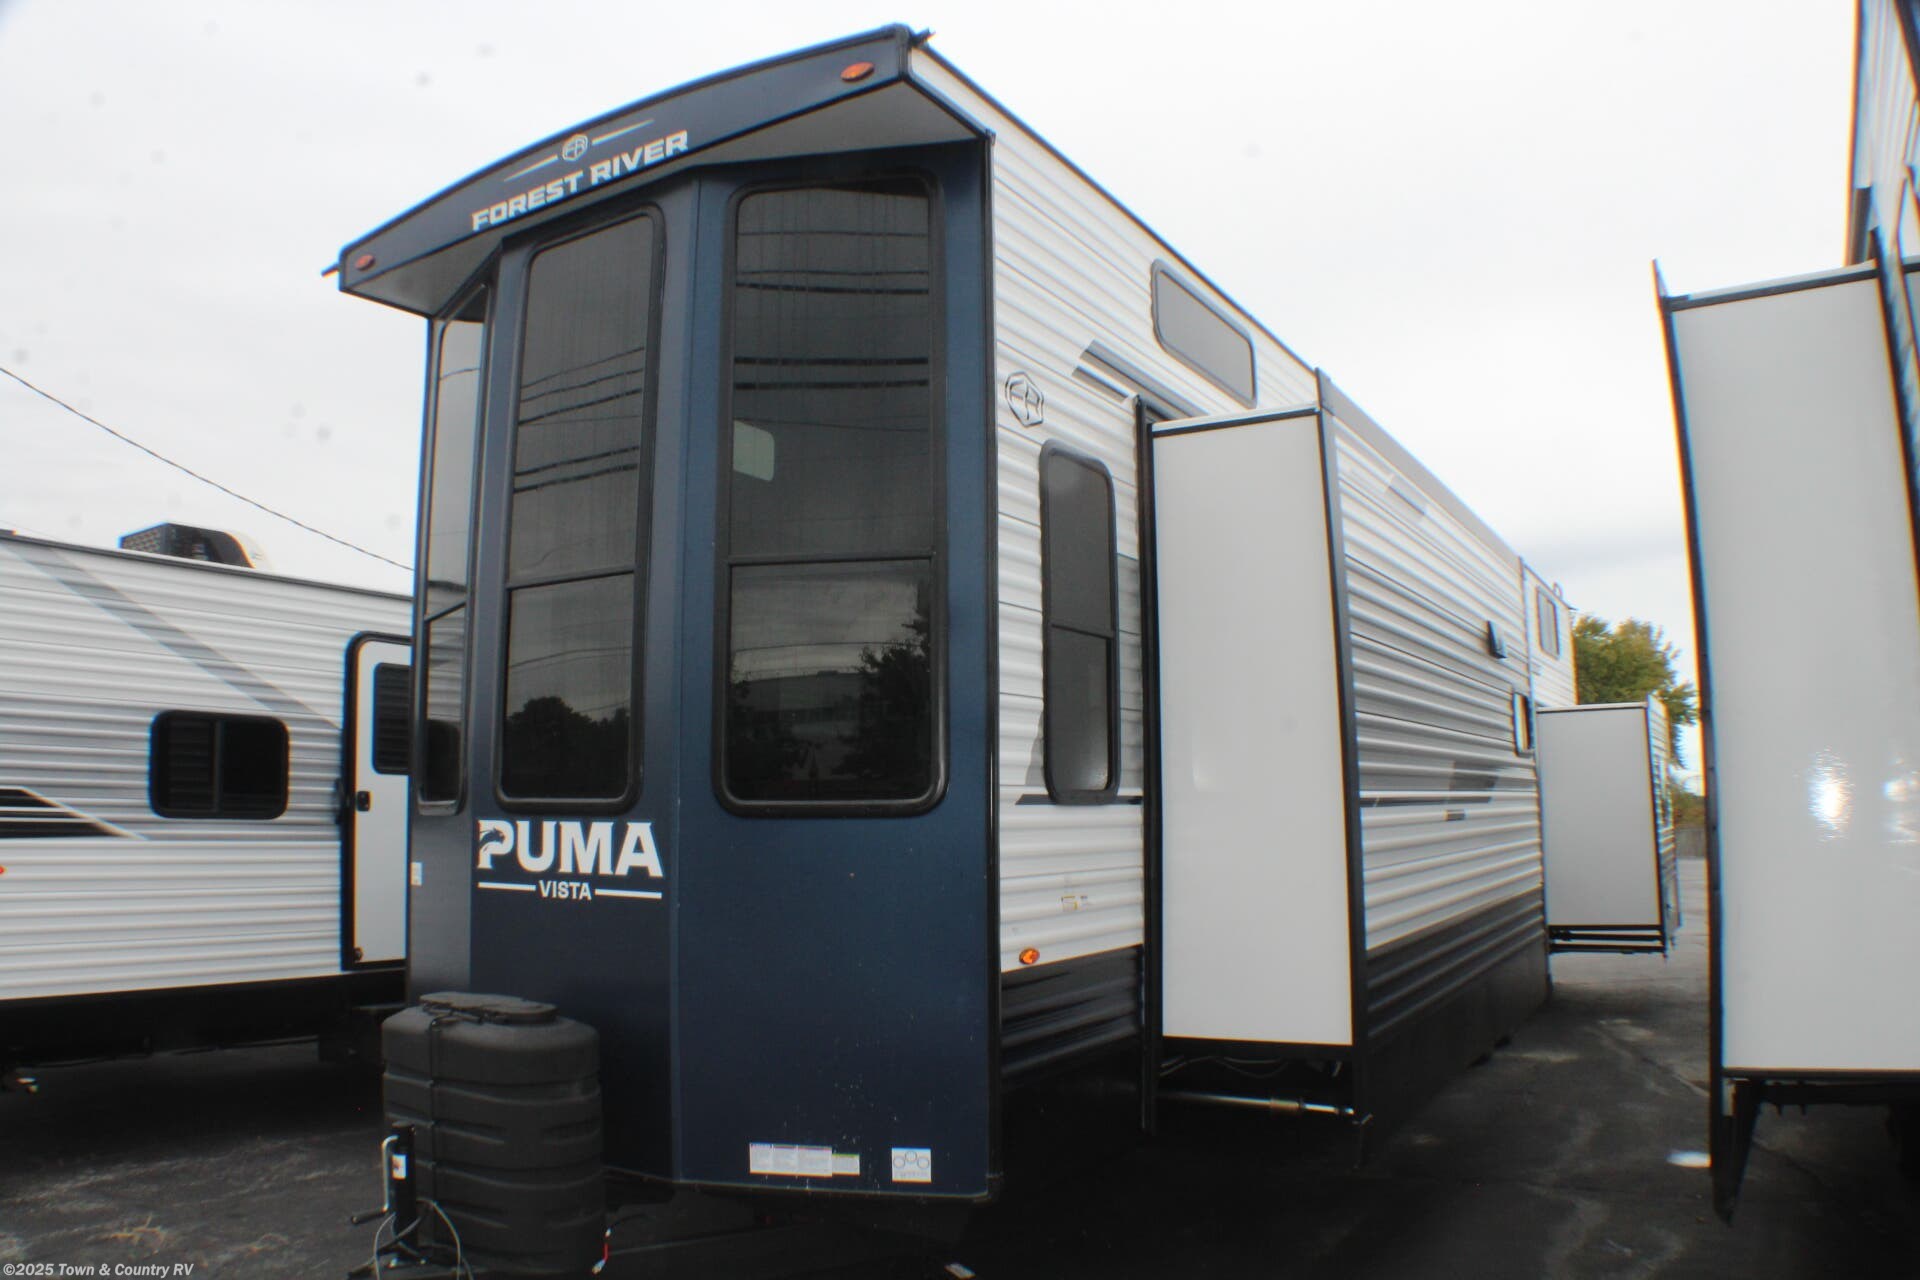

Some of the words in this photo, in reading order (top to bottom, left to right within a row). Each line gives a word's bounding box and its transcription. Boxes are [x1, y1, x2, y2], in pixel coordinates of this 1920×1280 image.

[471, 170, 584, 231] FOREST
[590, 130, 689, 186] RIVER
[477, 819, 664, 877] PUMA
[538, 879, 592, 901] VISTA
